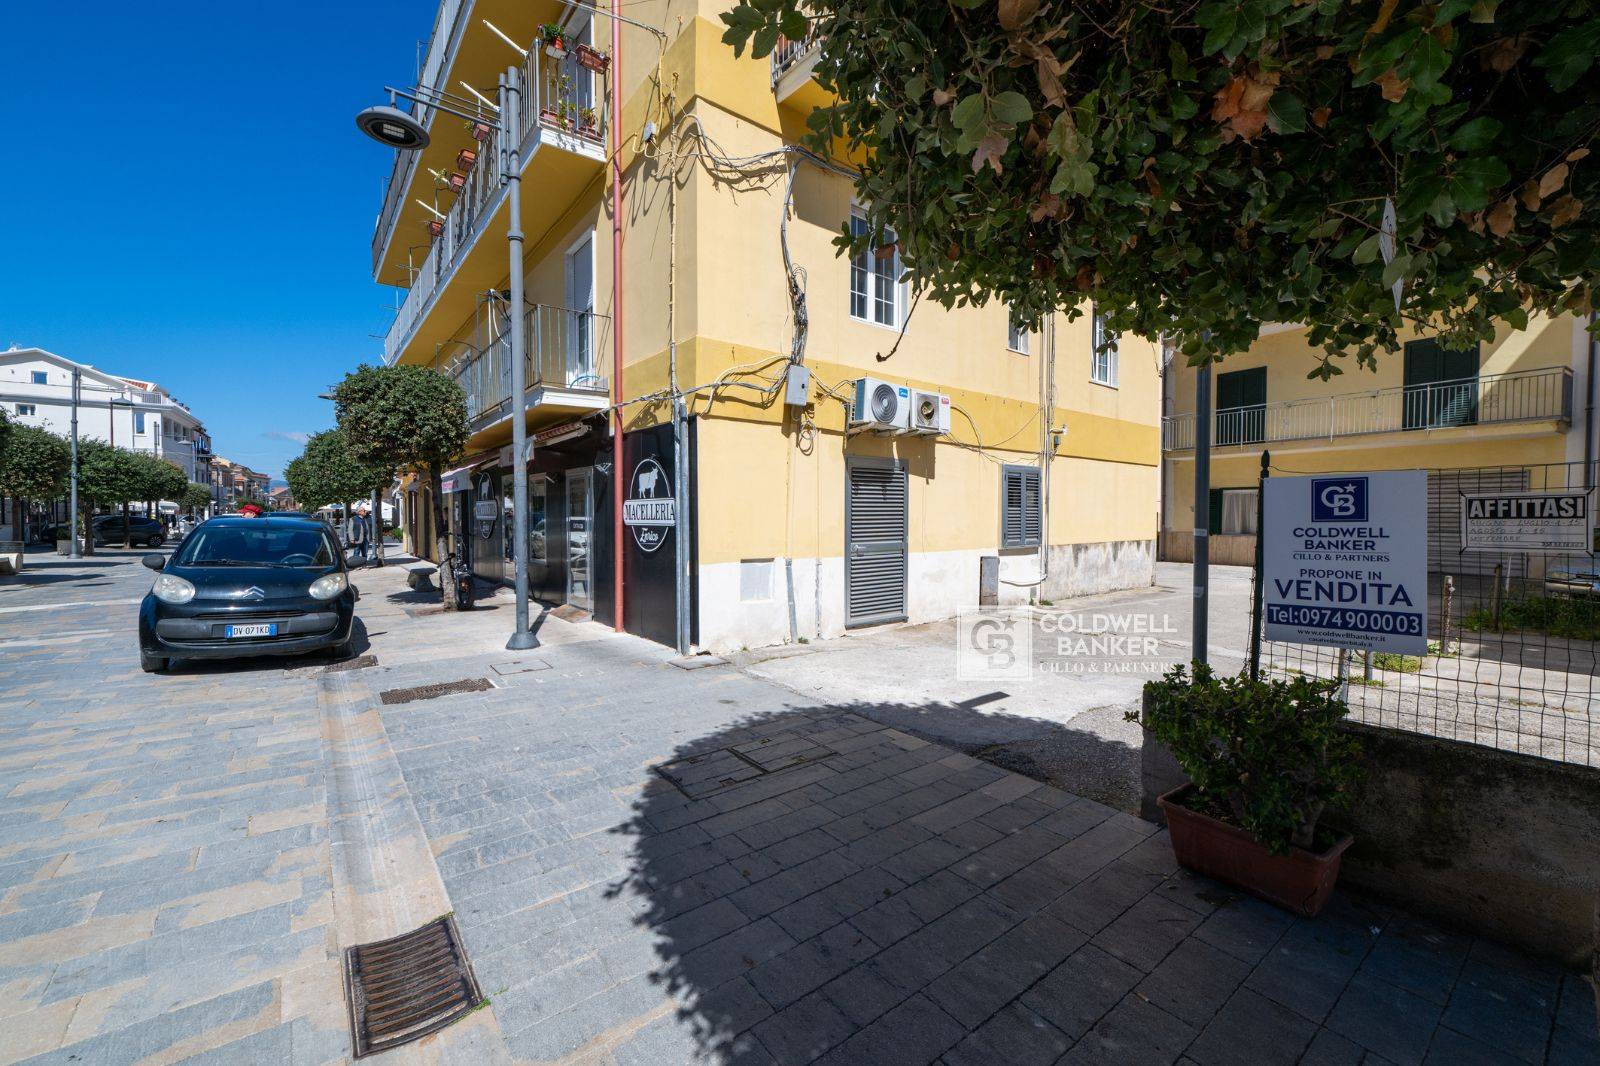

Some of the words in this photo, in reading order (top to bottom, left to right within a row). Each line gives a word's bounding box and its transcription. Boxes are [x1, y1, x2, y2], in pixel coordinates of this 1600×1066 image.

[625, 503, 675, 520] MACELLERIA
[1469, 497, 1584, 518] AFFITTASI
[1293, 527, 1390, 538] COLDWELL
[1304, 540, 1376, 551] BANKER
[1293, 553, 1322, 561] CILLO
[1324, 553, 1332, 561] &
[1335, 554, 1390, 563] PARTNERS
[1300, 568, 1363, 580] PROPONE
[1368, 571, 1382, 580] IN
[1274, 578, 1413, 607] VENDITA
[1297, 628, 1386, 642] www.coldwellbanker.it
